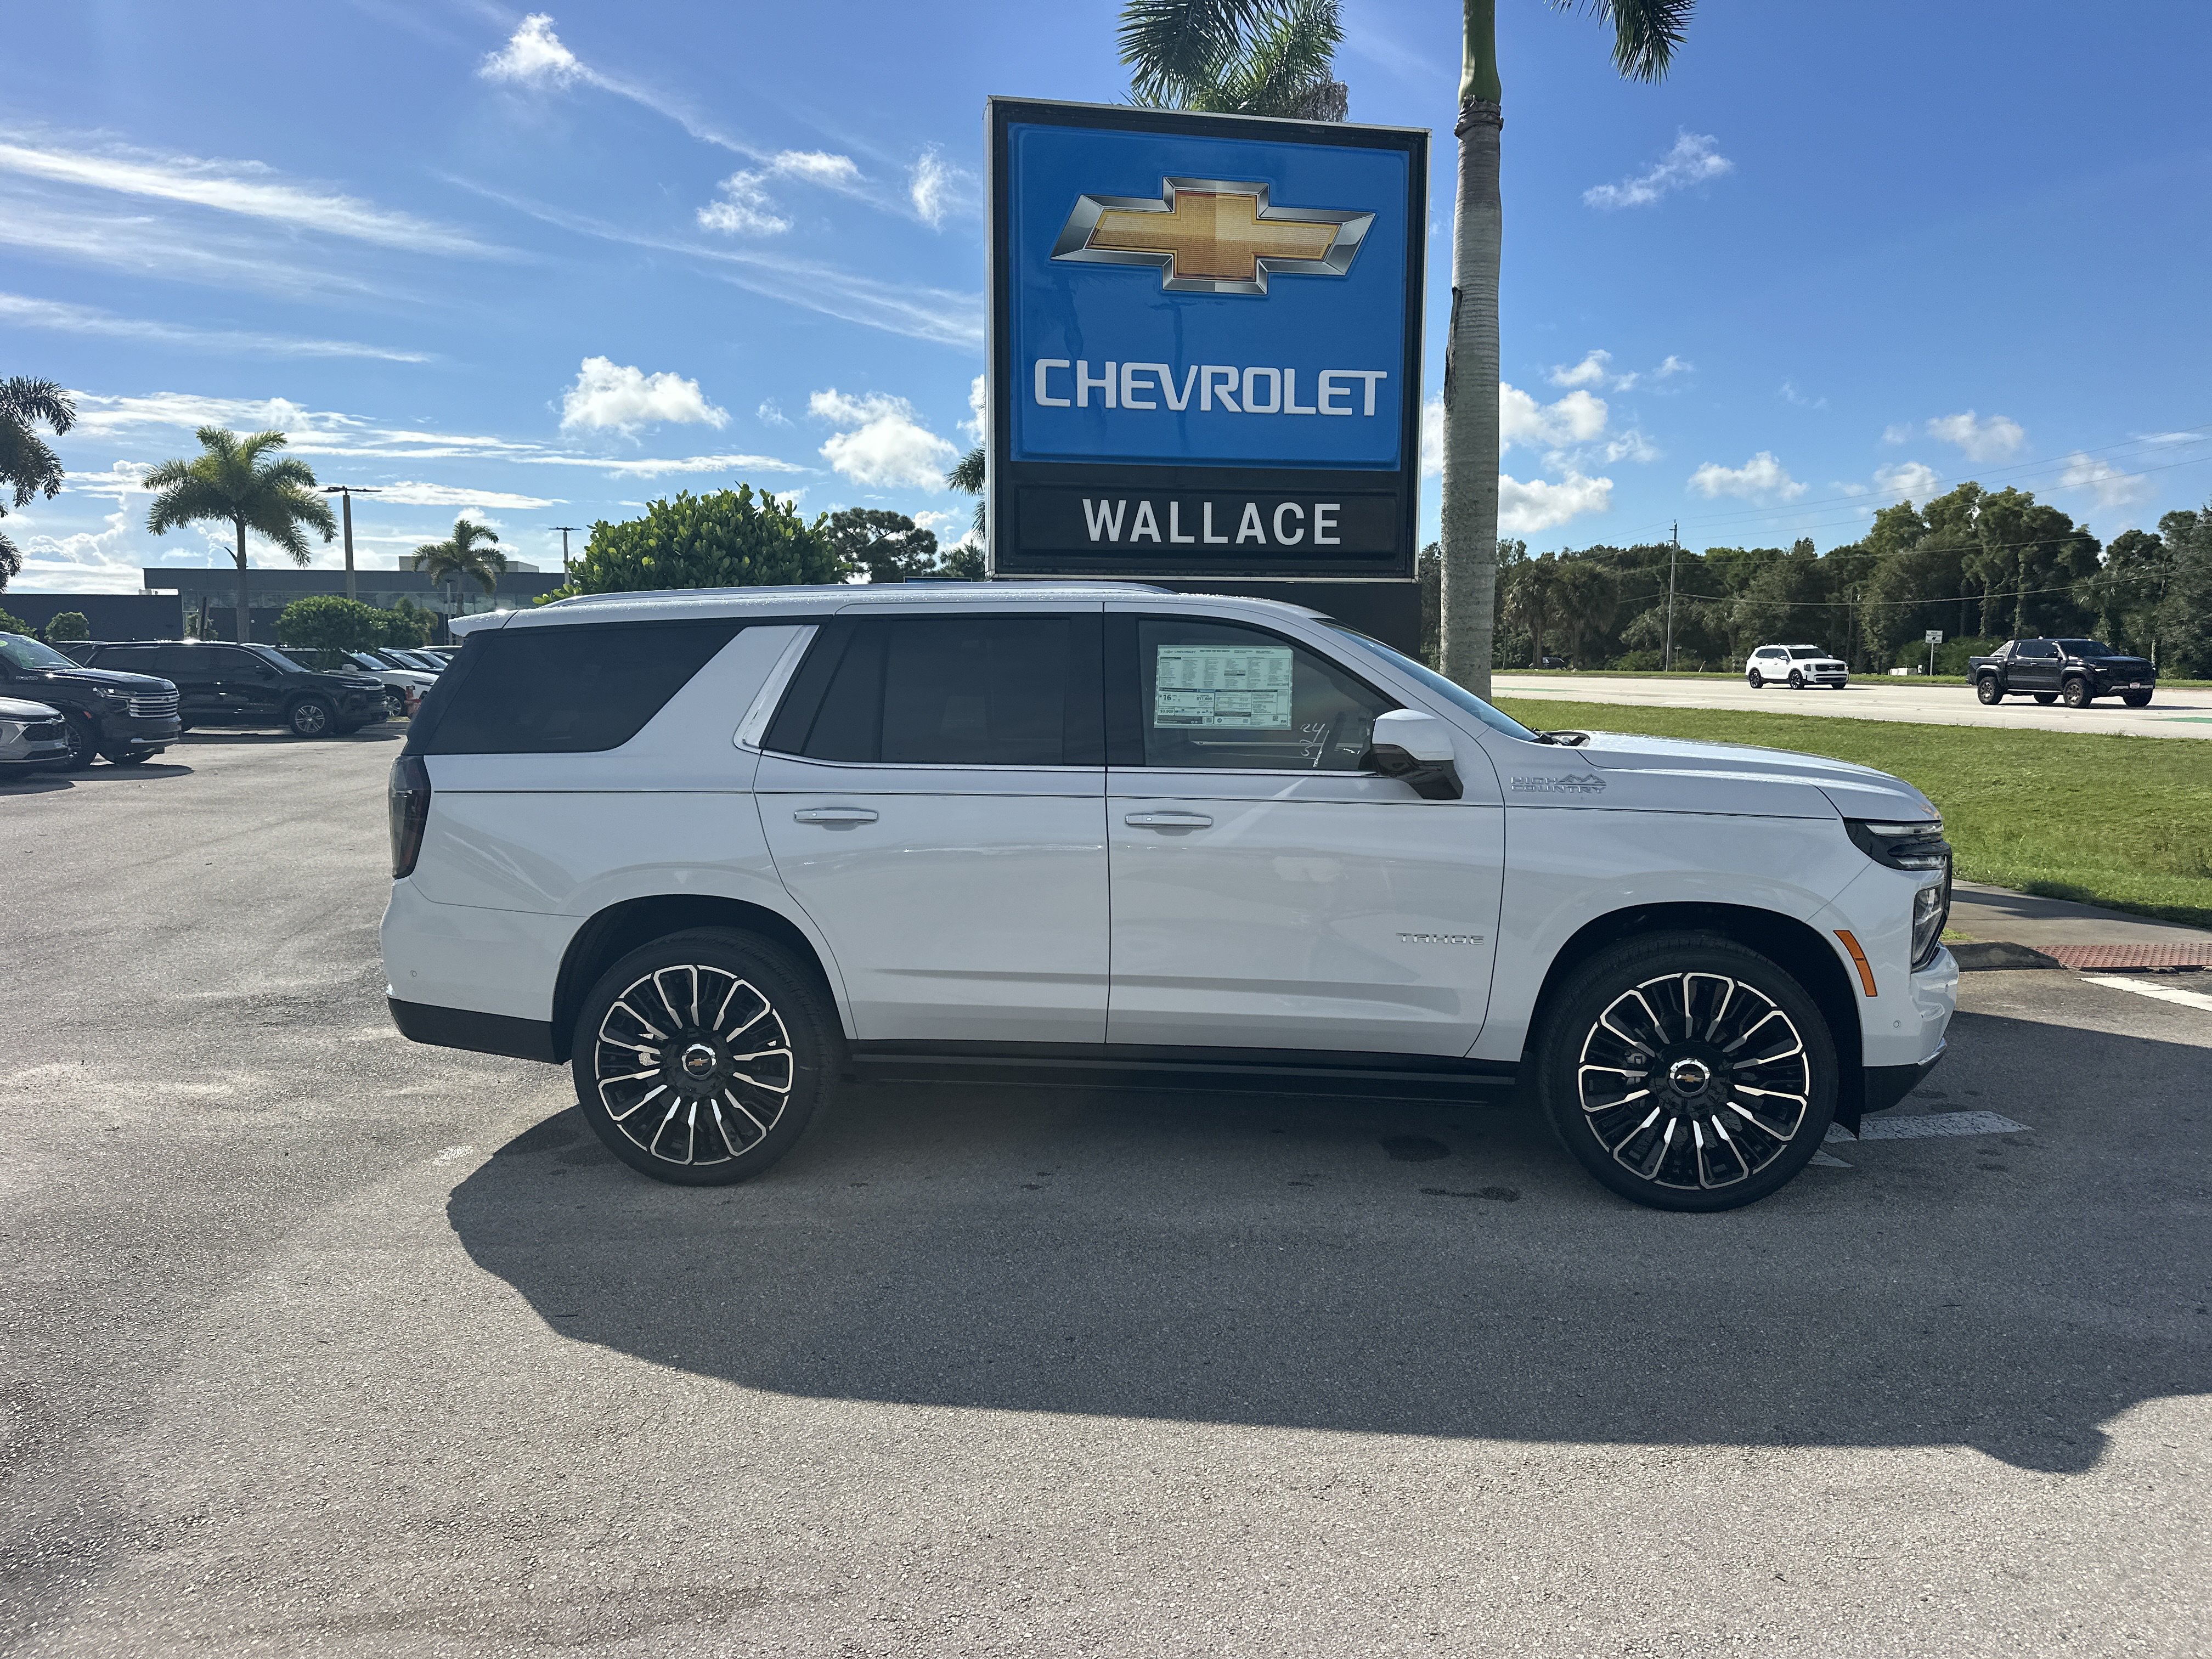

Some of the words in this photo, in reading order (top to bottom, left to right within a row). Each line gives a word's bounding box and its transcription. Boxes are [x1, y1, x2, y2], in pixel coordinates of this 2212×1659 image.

[1034, 358, 1387, 416] CHEVROLET
[1082, 499, 1340, 545] WALLACE
[1510, 776, 1559, 785] HIGH
[1511, 785, 1607, 794] COUNTRY
[1395, 932, 1485, 945] TAHOE
